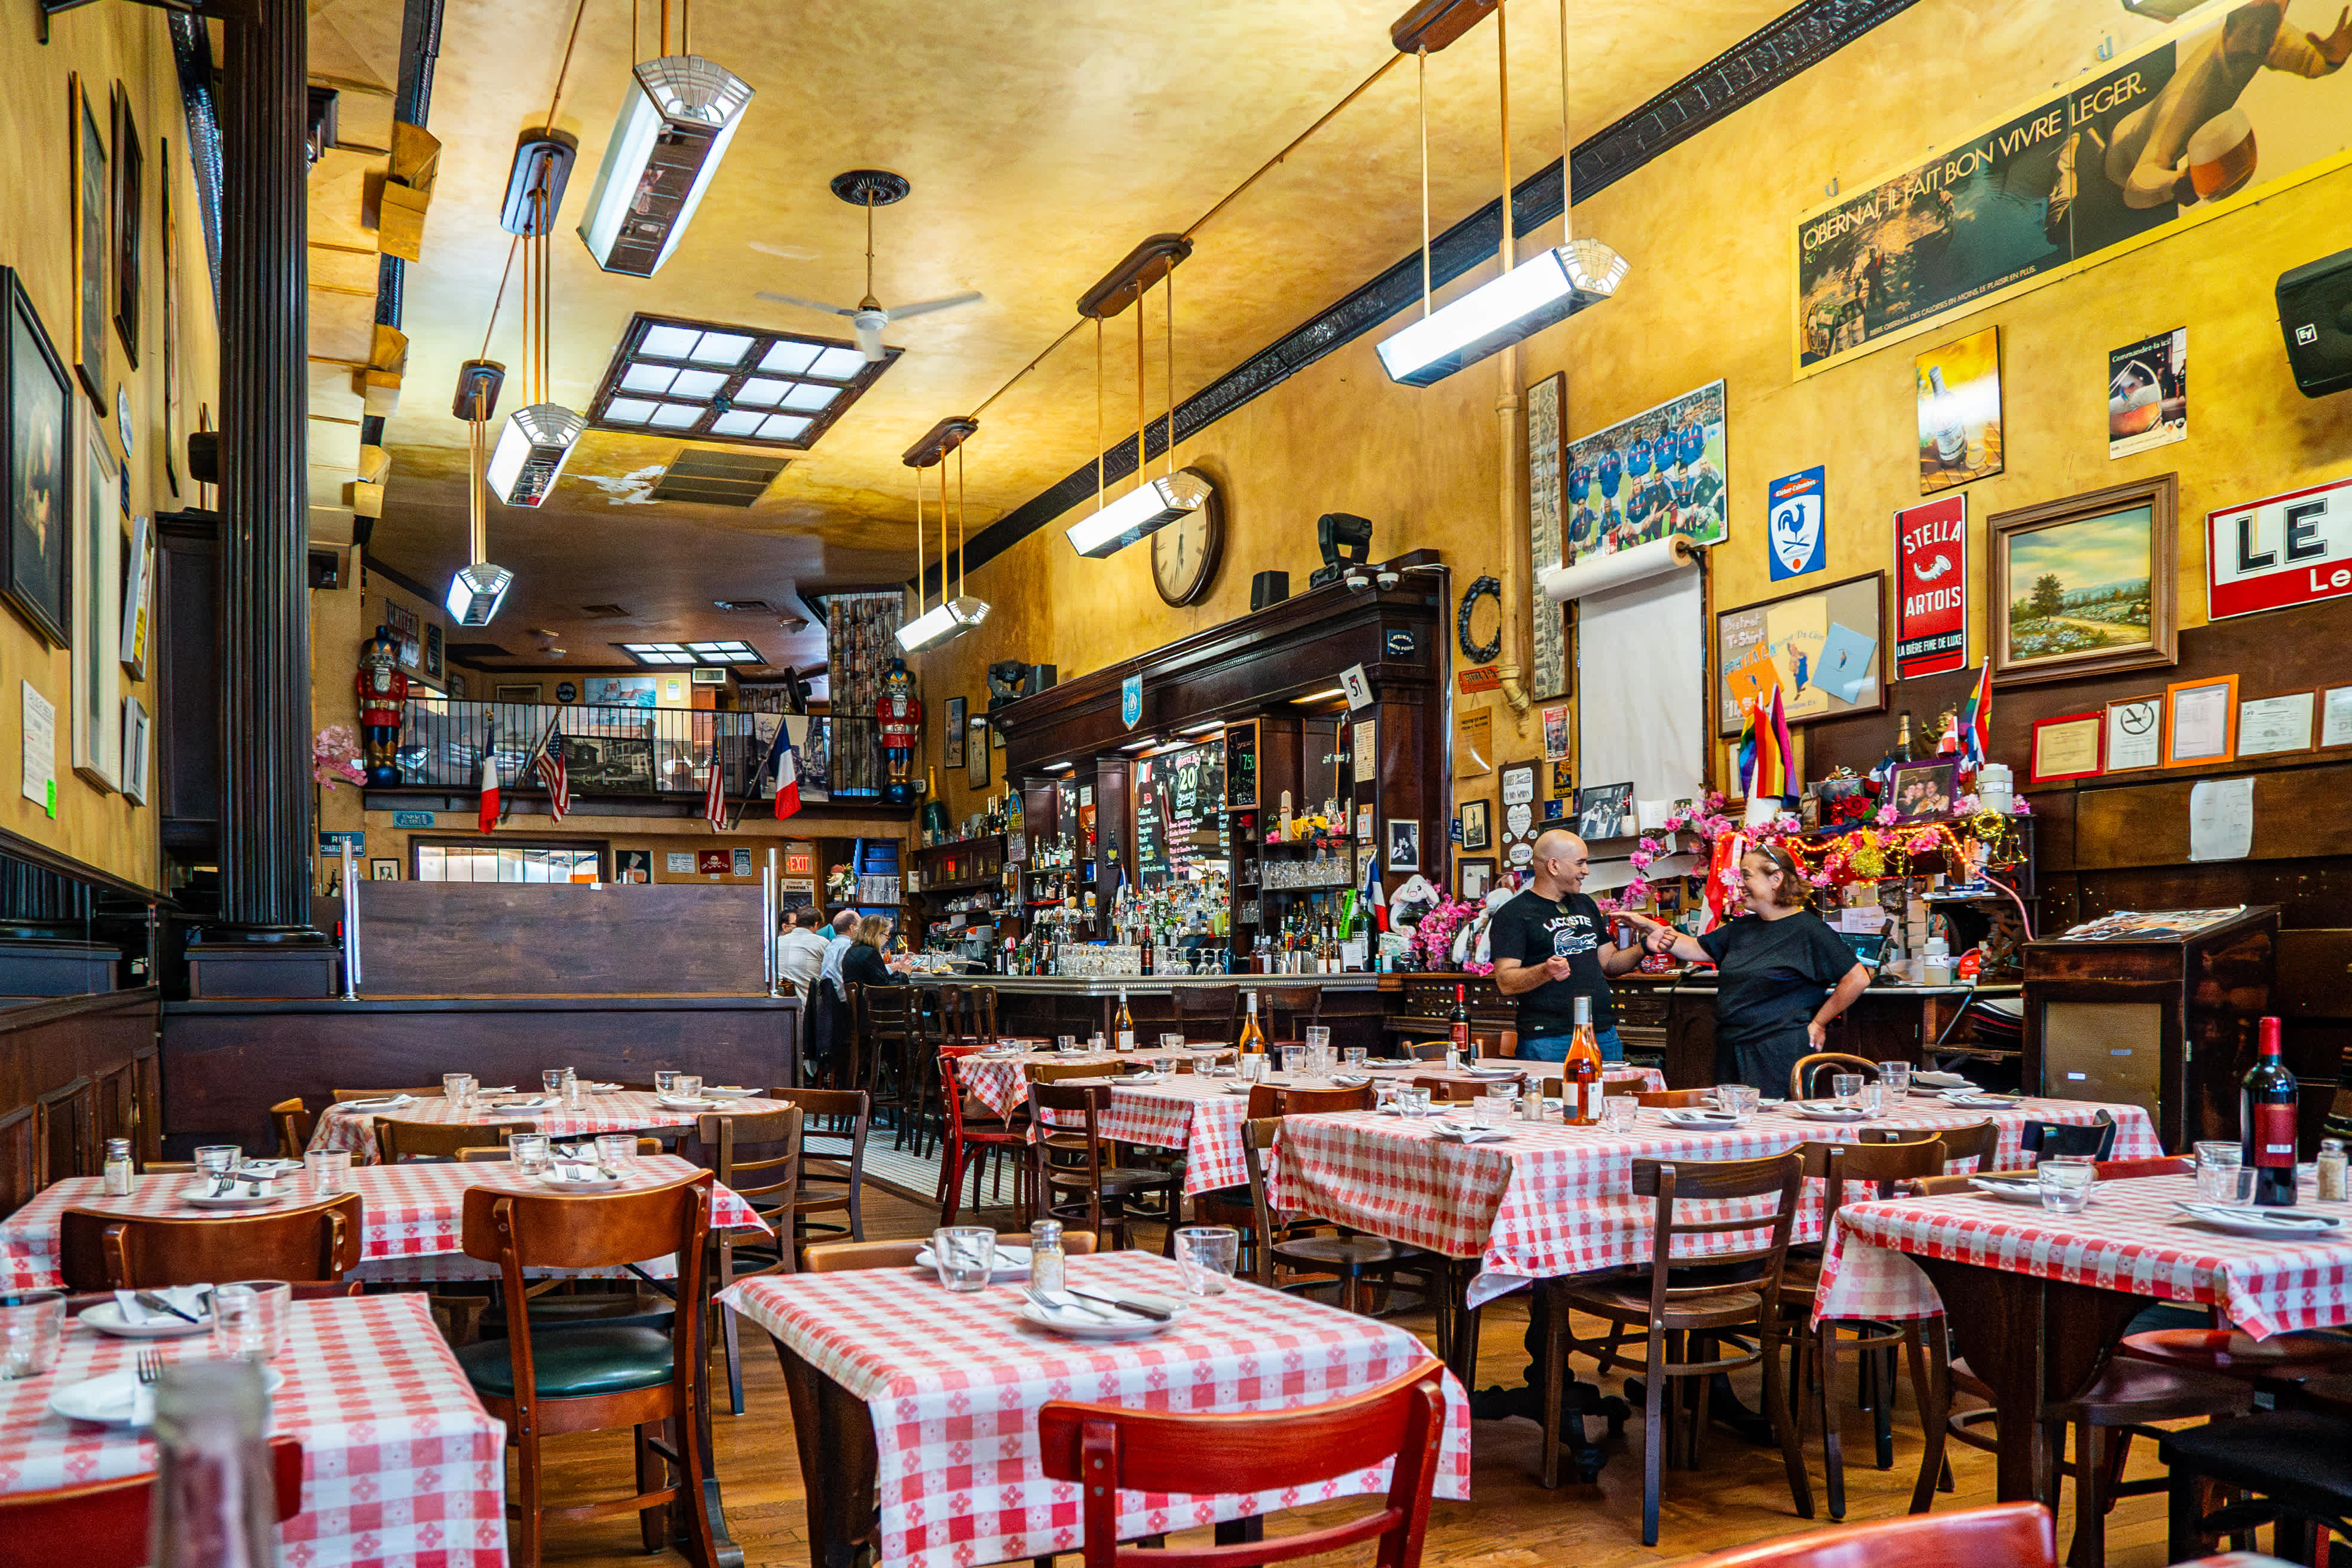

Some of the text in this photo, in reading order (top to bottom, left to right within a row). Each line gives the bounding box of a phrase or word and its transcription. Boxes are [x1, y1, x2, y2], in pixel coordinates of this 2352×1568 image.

[1888, 189, 1900, 212] IL
[1905, 167, 1941, 203] FAIT
[1944, 141, 1993, 186] BON
[1998, 109, 2062, 158] VIVRE
[2071, 71, 2146, 127] LEGER.
[1903, 520, 1962, 555] STELLA
[2236, 497, 2328, 575] LE
[1905, 586, 1962, 618] ARTOIS
[1897, 645, 1906, 657] LA
[1924, 639, 1937, 651] FINE
[1938, 636, 1946, 649] DE
[1947, 634, 1962, 647] LUXE
[1348, 674, 1362, 697] 51
[1180, 767, 1196, 791] 20
[1359, 821, 1367, 832] 17
[789, 855, 810, 871] EXIT
